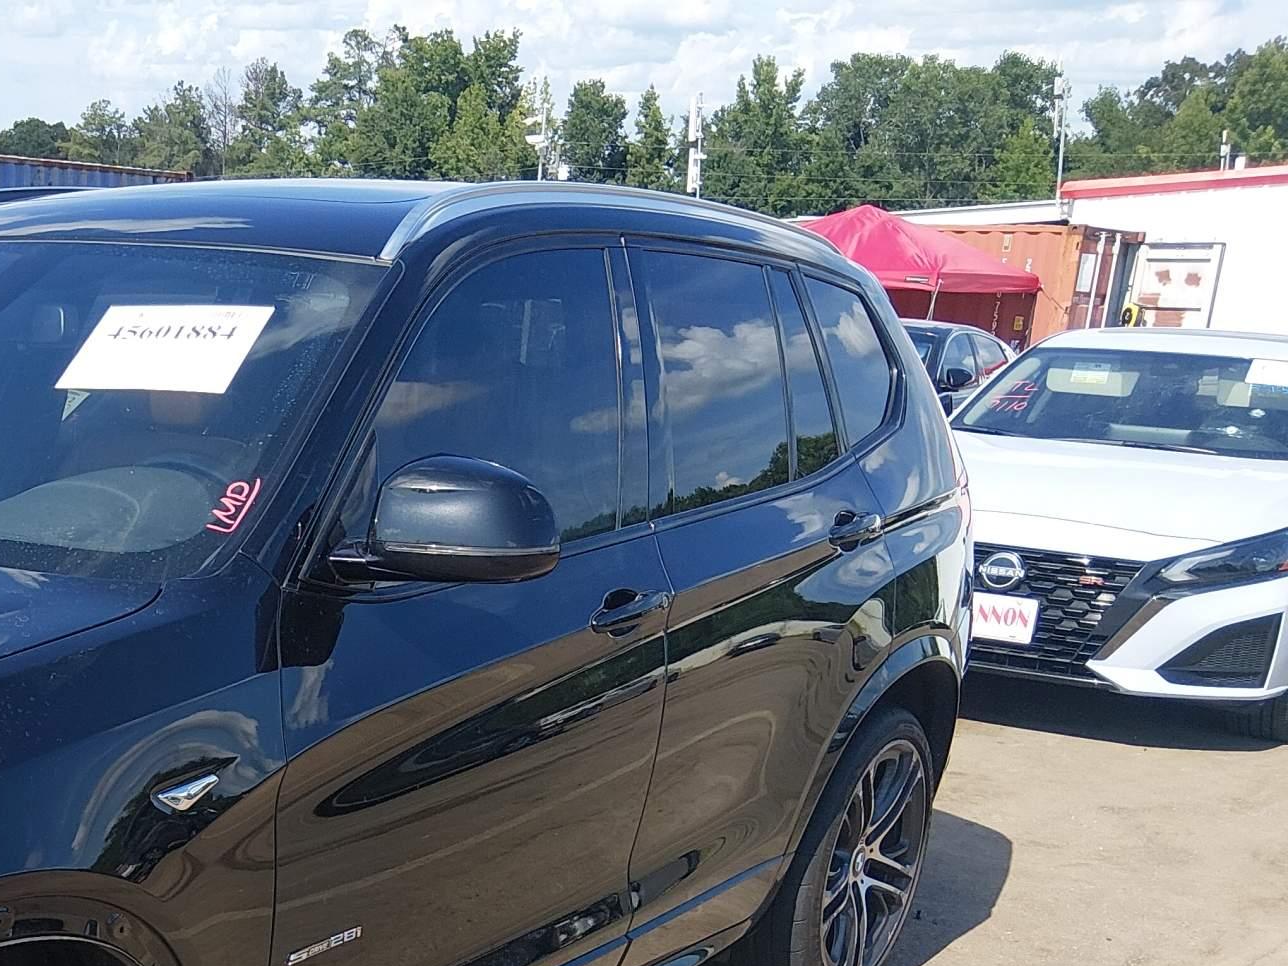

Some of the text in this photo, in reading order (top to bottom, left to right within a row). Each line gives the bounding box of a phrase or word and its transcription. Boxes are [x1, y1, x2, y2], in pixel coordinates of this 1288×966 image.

[107, 325, 238, 341] 45601884
[978, 564, 1025, 578] NISSAN
[1078, 575, 1105, 587] SR
